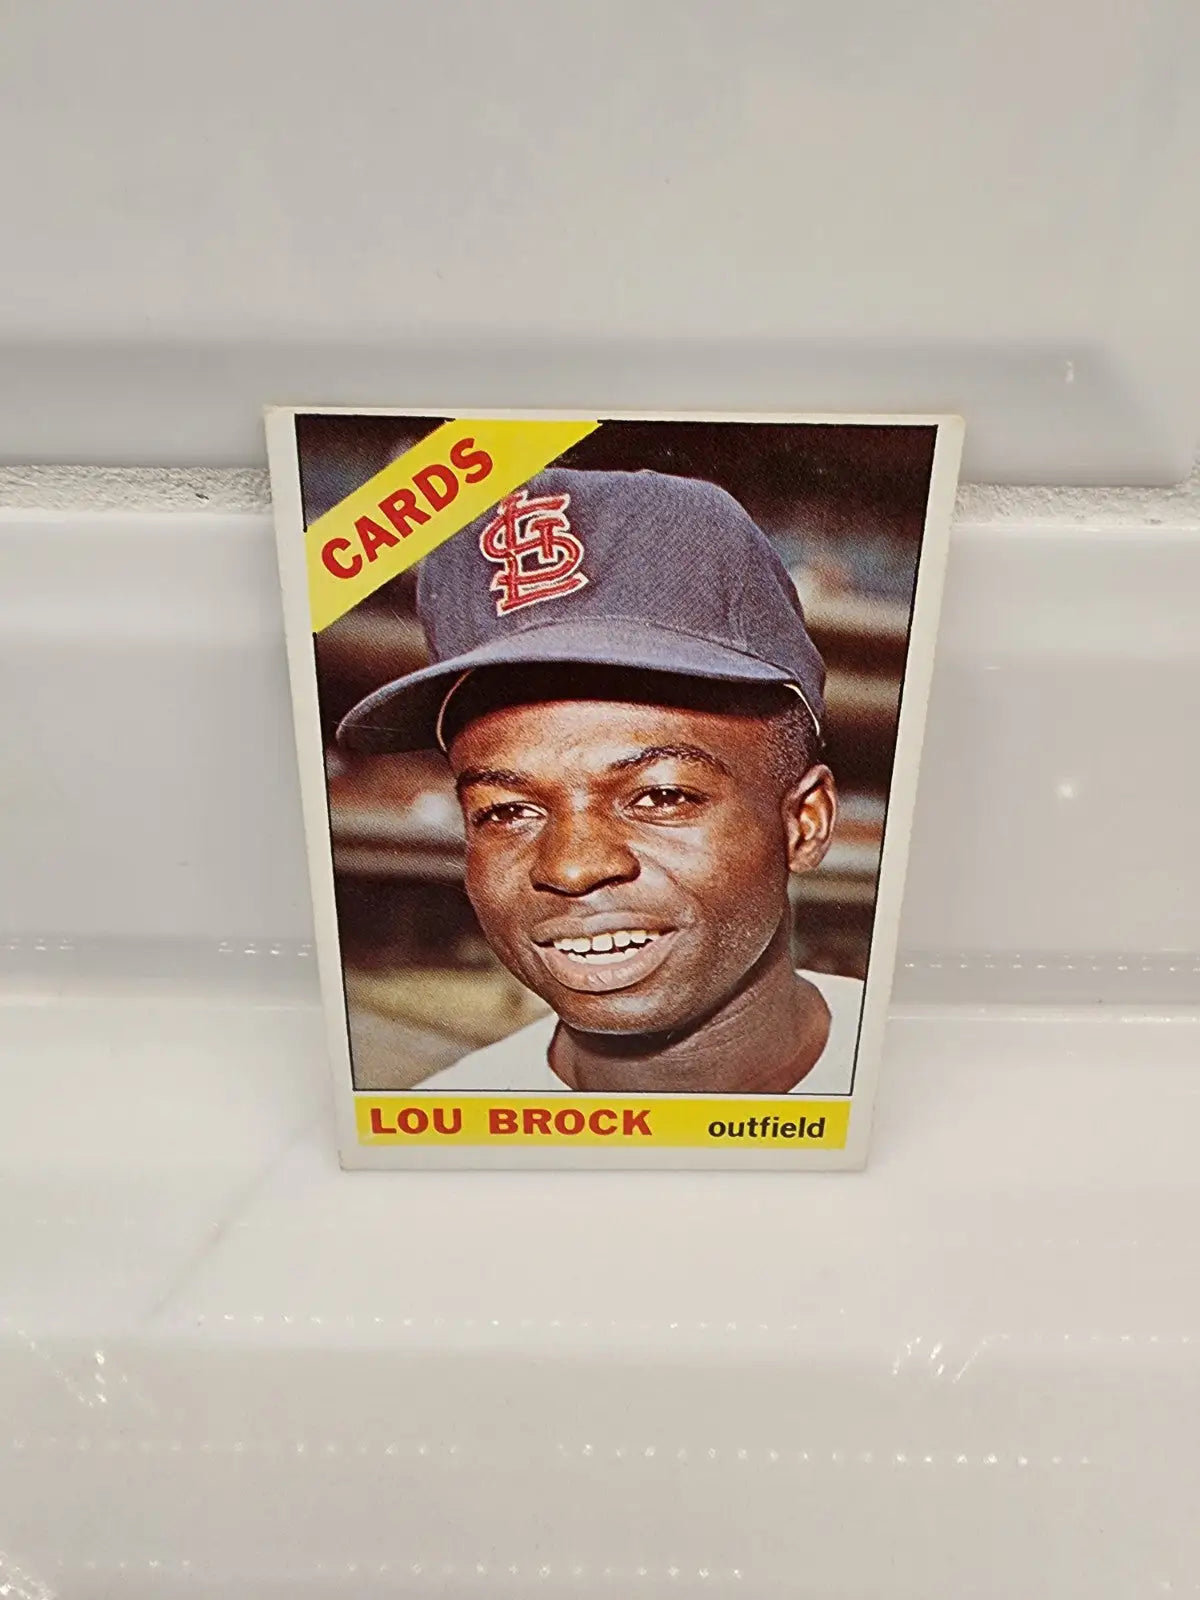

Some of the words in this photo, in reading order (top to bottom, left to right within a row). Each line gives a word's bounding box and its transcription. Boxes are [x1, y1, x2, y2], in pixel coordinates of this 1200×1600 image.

[320, 437, 494, 580] CARDS
[370, 1107, 463, 1135] LOU
[488, 1107, 652, 1137] BROCK
[707, 1116, 826, 1139] outfield
